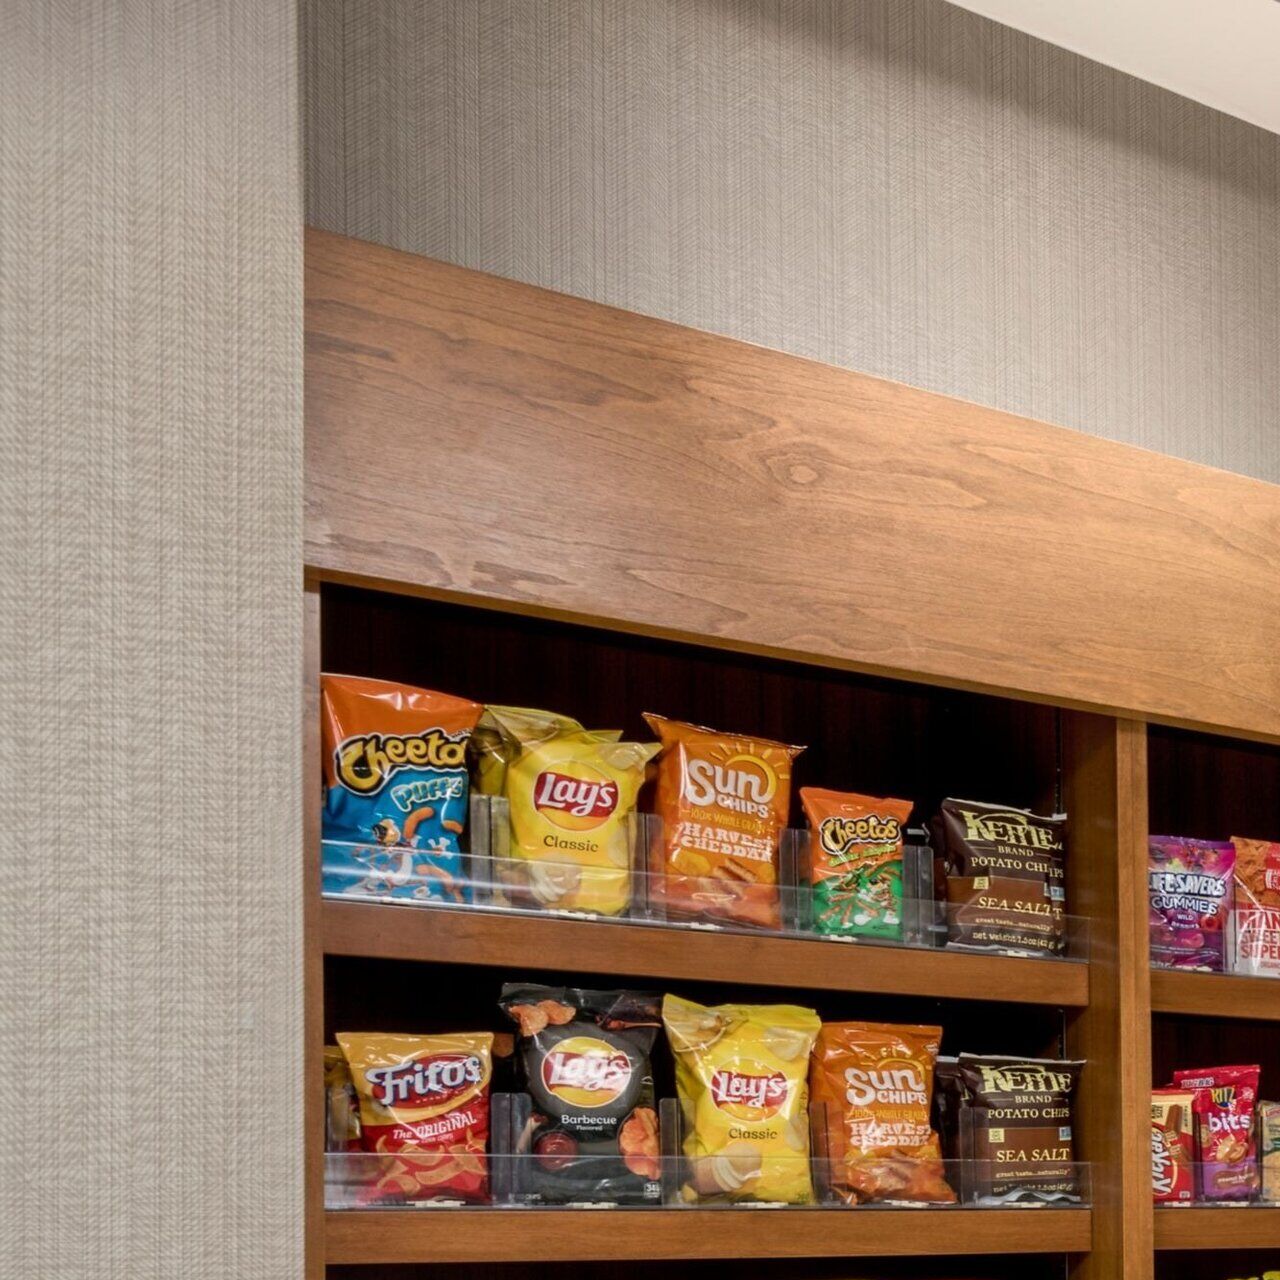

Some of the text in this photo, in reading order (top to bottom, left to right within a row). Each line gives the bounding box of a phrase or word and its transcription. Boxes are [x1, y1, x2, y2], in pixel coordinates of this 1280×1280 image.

[335, 731, 465, 793] Cheeto
[685, 757, 776, 807] Sun
[538, 772, 615, 816] Lay's
[718, 795, 770, 819] CHIPS
[683, 821, 774, 848] HARVEST
[822, 816, 900, 853] Cheetos
[959, 809, 1058, 850] KETTLE
[543, 835, 599, 853] Classic
[680, 835, 773, 863] CHEDDAR
[997, 845, 1034, 857] BRAND
[971, 856, 1022, 870] POTATO
[1176, 874, 1226, 897] SAVERS
[976, 896, 1009, 910] SEA
[1151, 896, 1219, 915] GUMMIES
[1177, 914, 1195, 922] WILD
[365, 1055, 483, 1107] Fritos
[549, 1051, 630, 1091] Lay's
[975, 1064, 1072, 1094] KETTLE
[717, 1070, 788, 1108] Lay's
[844, 1063, 927, 1106] Sun
[1210, 1086, 1236, 1103] RITZ
[876, 1090, 928, 1105] CHIPS
[1014, 1095, 1052, 1104] BRAND
[561, 1113, 617, 1126] Barbecue
[987, 1107, 1070, 1119] POTATO CHIPS
[1207, 1111, 1251, 1133] bits
[393, 1111, 477, 1140] The ORIGINAL
[576, 1124, 603, 1132] Flavored
[728, 1127, 778, 1140] Classic
[850, 1122, 932, 1135] HARVEST
[996, 1147, 1070, 1163] SEA SALT
